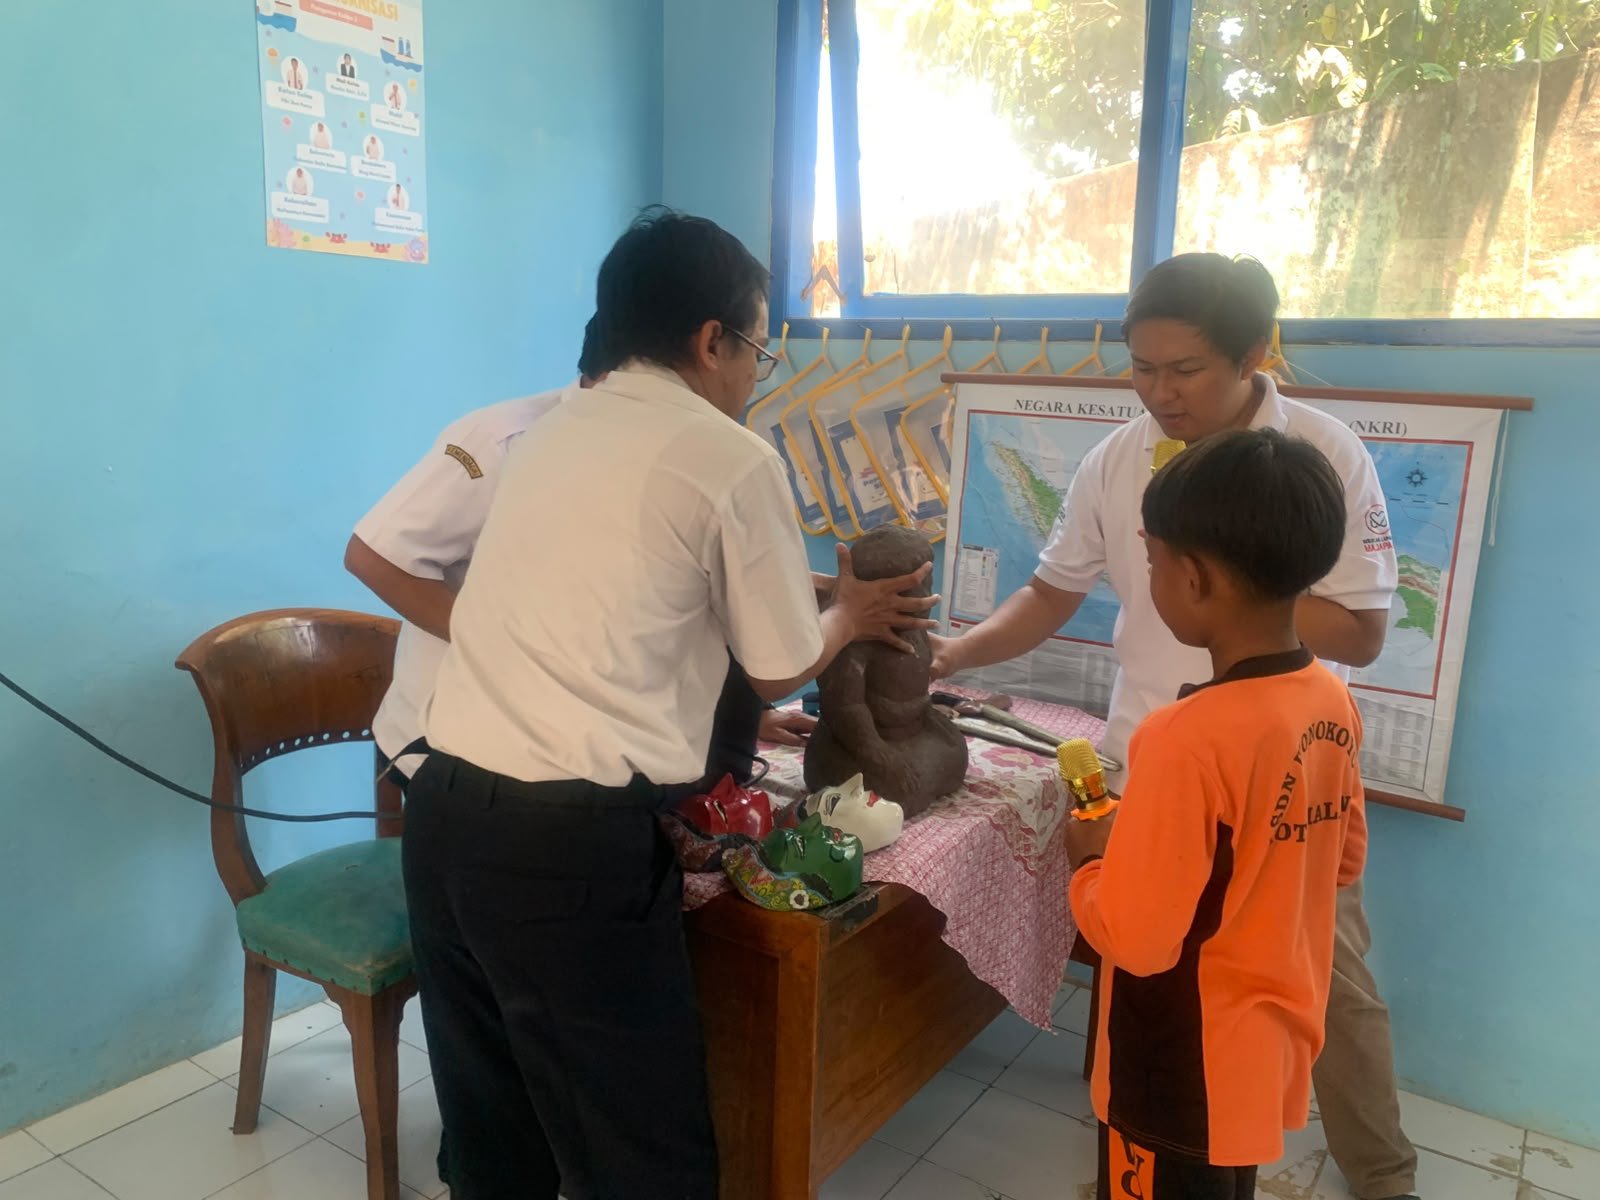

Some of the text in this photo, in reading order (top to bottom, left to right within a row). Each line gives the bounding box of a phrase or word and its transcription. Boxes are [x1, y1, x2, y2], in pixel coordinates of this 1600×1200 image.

[1015, 399, 1408, 437] NEGARA KESATUA (NKRI)
